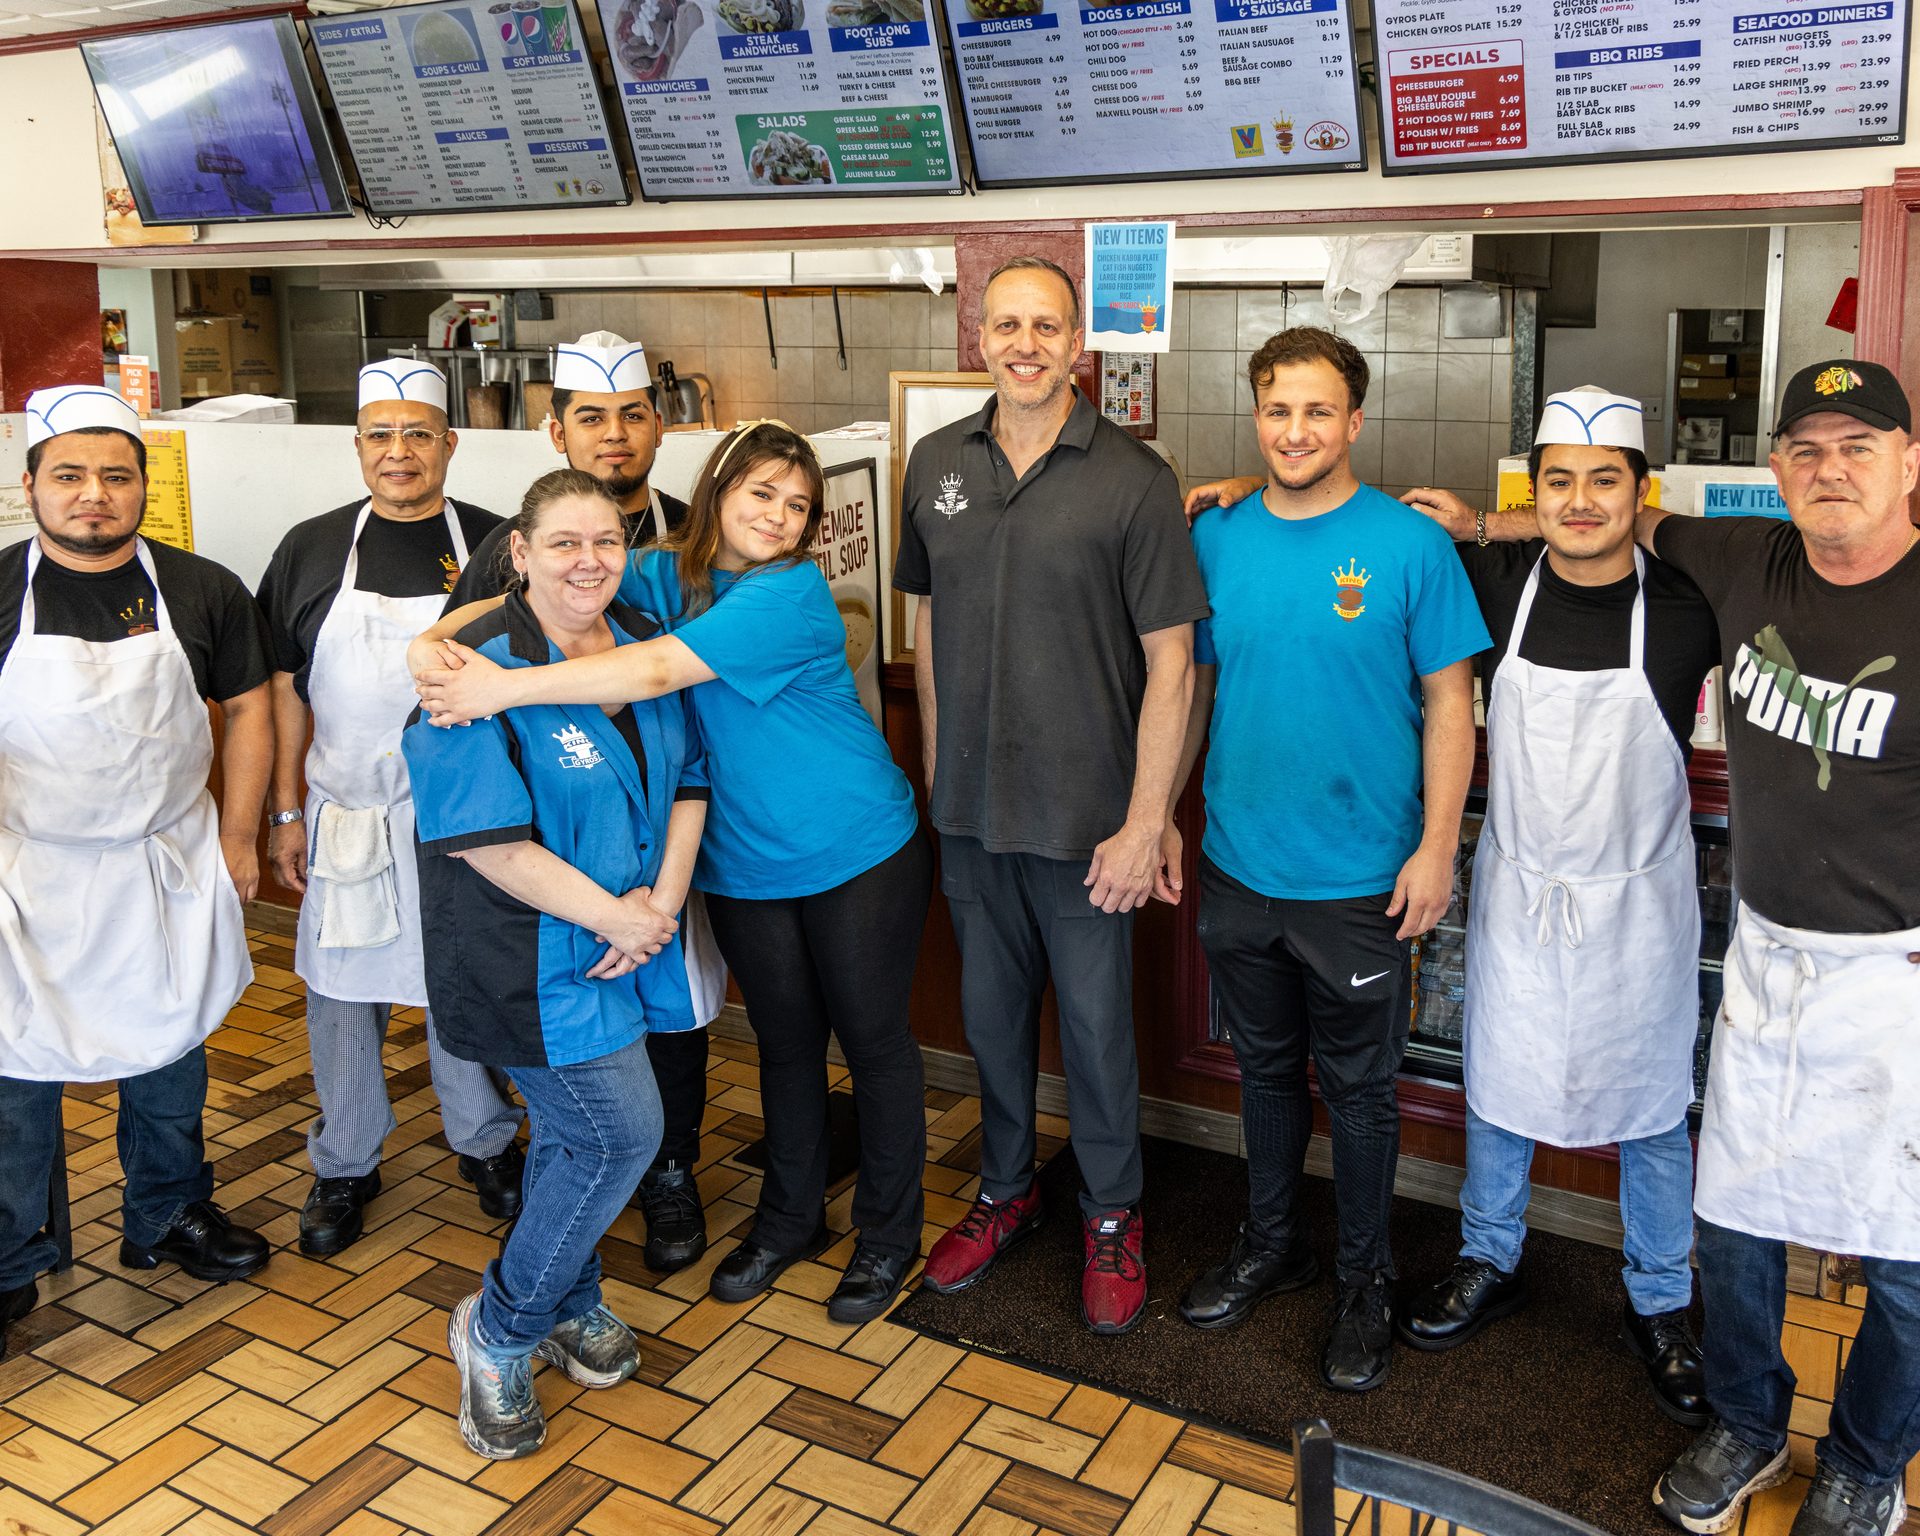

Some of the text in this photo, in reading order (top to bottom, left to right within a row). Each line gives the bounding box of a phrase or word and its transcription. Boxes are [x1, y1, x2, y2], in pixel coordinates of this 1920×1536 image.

[1089, 2, 1182, 22] DOGS & POLISH
[1239, 1, 1312, 17] & SAUSAGE
[1386, 5, 1521, 25] GYROS PLATE 15.29
[1738, 5, 1887, 31] SEAFOOD DINNERS
[320, 25, 381, 40] SIDES EXTRAS
[845, 26, 910, 38] FOOT-LONG
[981, 19, 1032, 33] BURGERS
[1218, 27, 1248, 37] ITALIAN
[1316, 18, 1338, 27] 10.19
[747, 35, 779, 45] STEAK
[865, 37, 893, 47] SUBS
[962, 40, 1011, 50] CHEESEBURGER
[1086, 44, 1100, 52] HOT
[1179, 35, 1194, 43] 5.09
[1220, 33, 1340, 51] ITALIAN SAUSUAGE 8.19
[1734, 31, 1891, 49] CATFISH NUGGETS 13.99 23.99
[732, 43, 798, 56] SANDWICHES
[1590, 46, 1663, 64] BBQ RIBS
[513, 53, 570, 67] SOFT DRINKS
[965, 62, 990, 71] DOUBLE
[992, 57, 1043, 68] CHEESEBURGER
[977, 54, 994, 62] BABY
[1223, 56, 1342, 72] SAUSAGE COMBO 11.29
[1410, 49, 1499, 70] SPECIALS
[1733, 57, 1890, 71] FRIED PERCH 13.99 23.99
[423, 62, 480, 76] SOUPS & CHILI
[1556, 63, 1700, 82] RIB TIPS 14.99
[635, 82, 696, 93] SANDWICHES
[1396, 75, 1518, 92] CHEESEBURGER 4.99
[1733, 78, 1889, 94] LARGE SHRIMP 13.99 23.99
[971, 94, 1012, 103] HAMBURGER
[1397, 91, 1519, 105] BIG BABY DOUBLE 6.49
[1096, 109, 1130, 118] MAXWELL
[1133, 108, 1158, 116] POLISH
[1398, 110, 1520, 126] 2 HOT DOGS W/ FRIES 7.69
[758, 116, 806, 128] SALADS
[1558, 121, 1700, 131] FULL SLAB 24.99
[1732, 117, 1887, 134] FISH & CHIPS 15.99
[456, 130, 488, 142] SAUCES
[1312, 126, 1340, 134] TURANO
[545, 142, 588, 152] DESSERTS
[1400, 136, 1521, 152] RIB TIP BUCKET 26.99
[1095, 229, 1163, 245] NEW ITEMS
[127, 368, 143, 376] PICK
[130, 378, 139, 386] UP
[126, 388, 144, 396] HERE
[1708, 489, 1786, 508] NEW ITE
[814, 501, 863, 548] EMADE
[840, 536, 868, 576] SOUP
[1729, 643, 1895, 758] PUMA
[575, 756, 598, 765] GYROS
